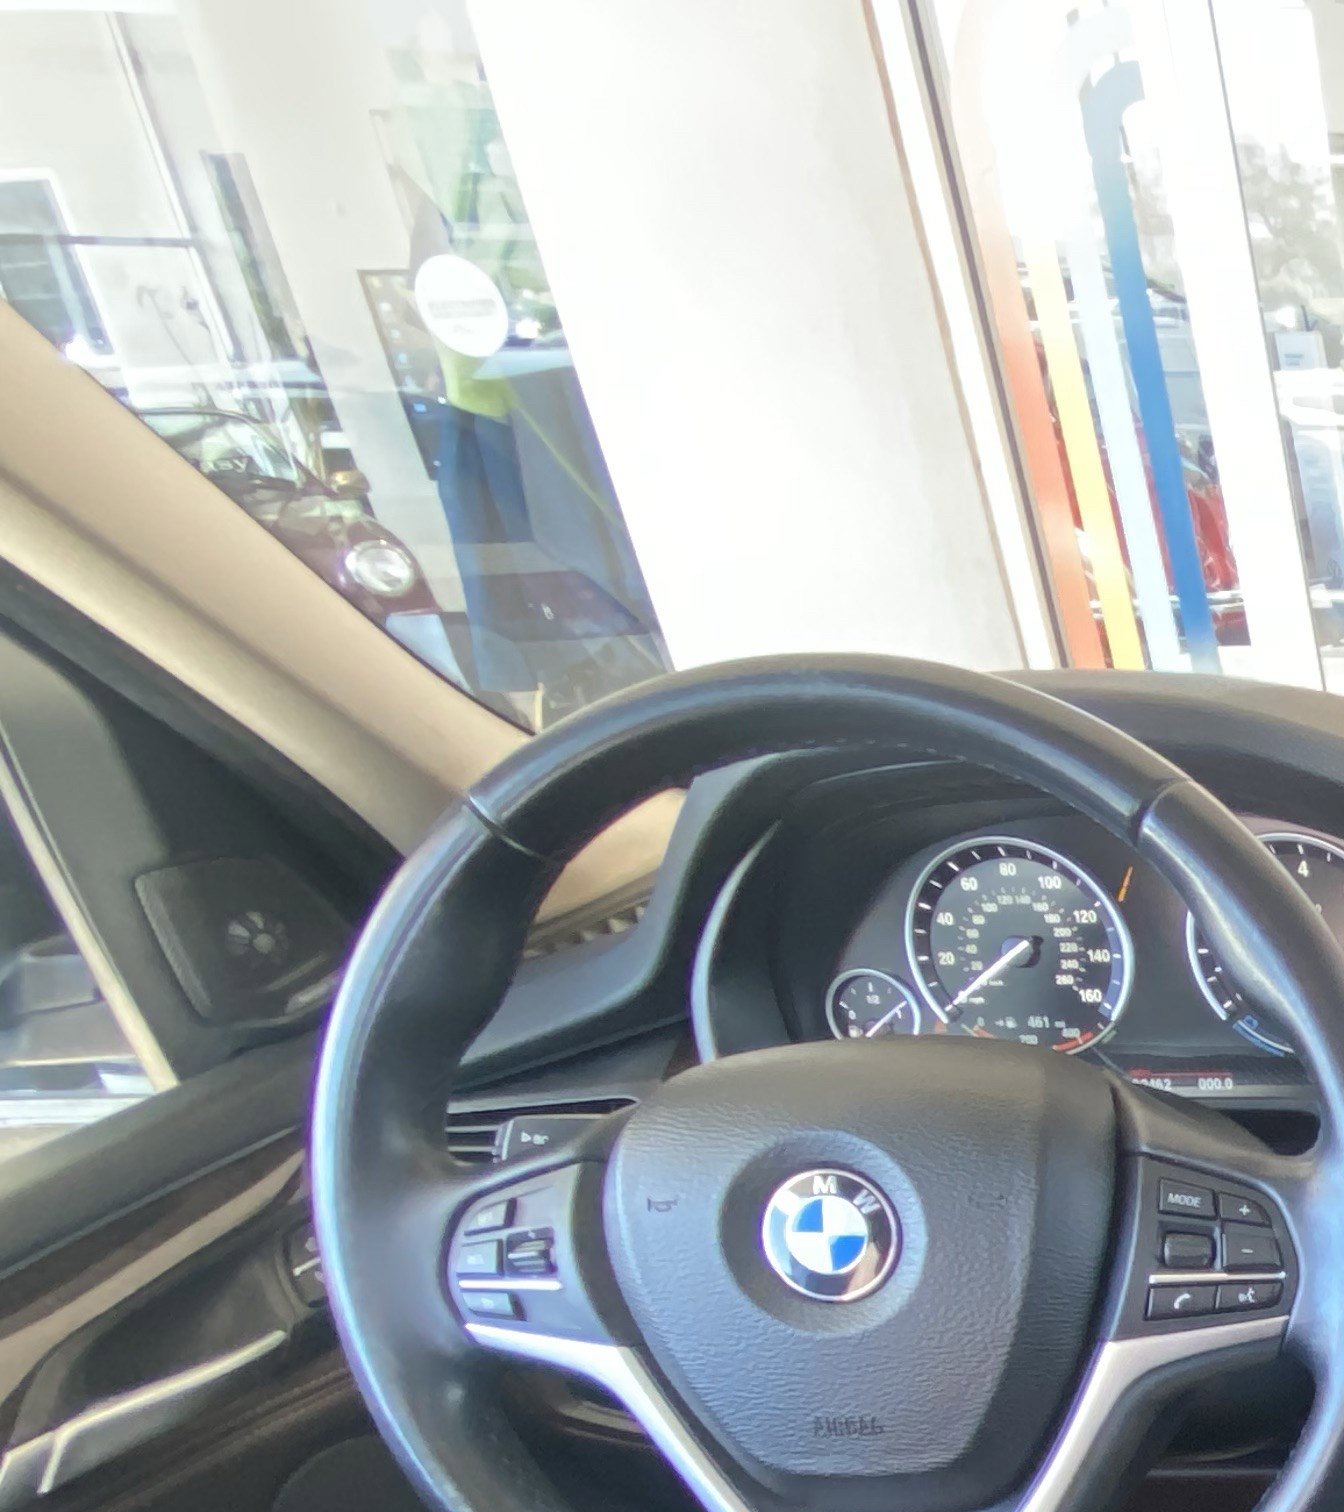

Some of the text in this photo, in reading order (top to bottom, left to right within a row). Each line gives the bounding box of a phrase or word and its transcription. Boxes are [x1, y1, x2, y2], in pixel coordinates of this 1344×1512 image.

[999, 862, 1017, 877] 80
[1298, 862, 1310, 878] 4
[960, 876, 979, 891] 60
[1037, 876, 1062, 890] 100
[936, 911, 955, 927] 40
[1073, 909, 1098, 924] 120
[937, 951, 956, 966] 20
[1087, 949, 1111, 963] 140
[1079, 988, 1103, 1003] 160
[1167, 1191, 1202, 1208] MODE
